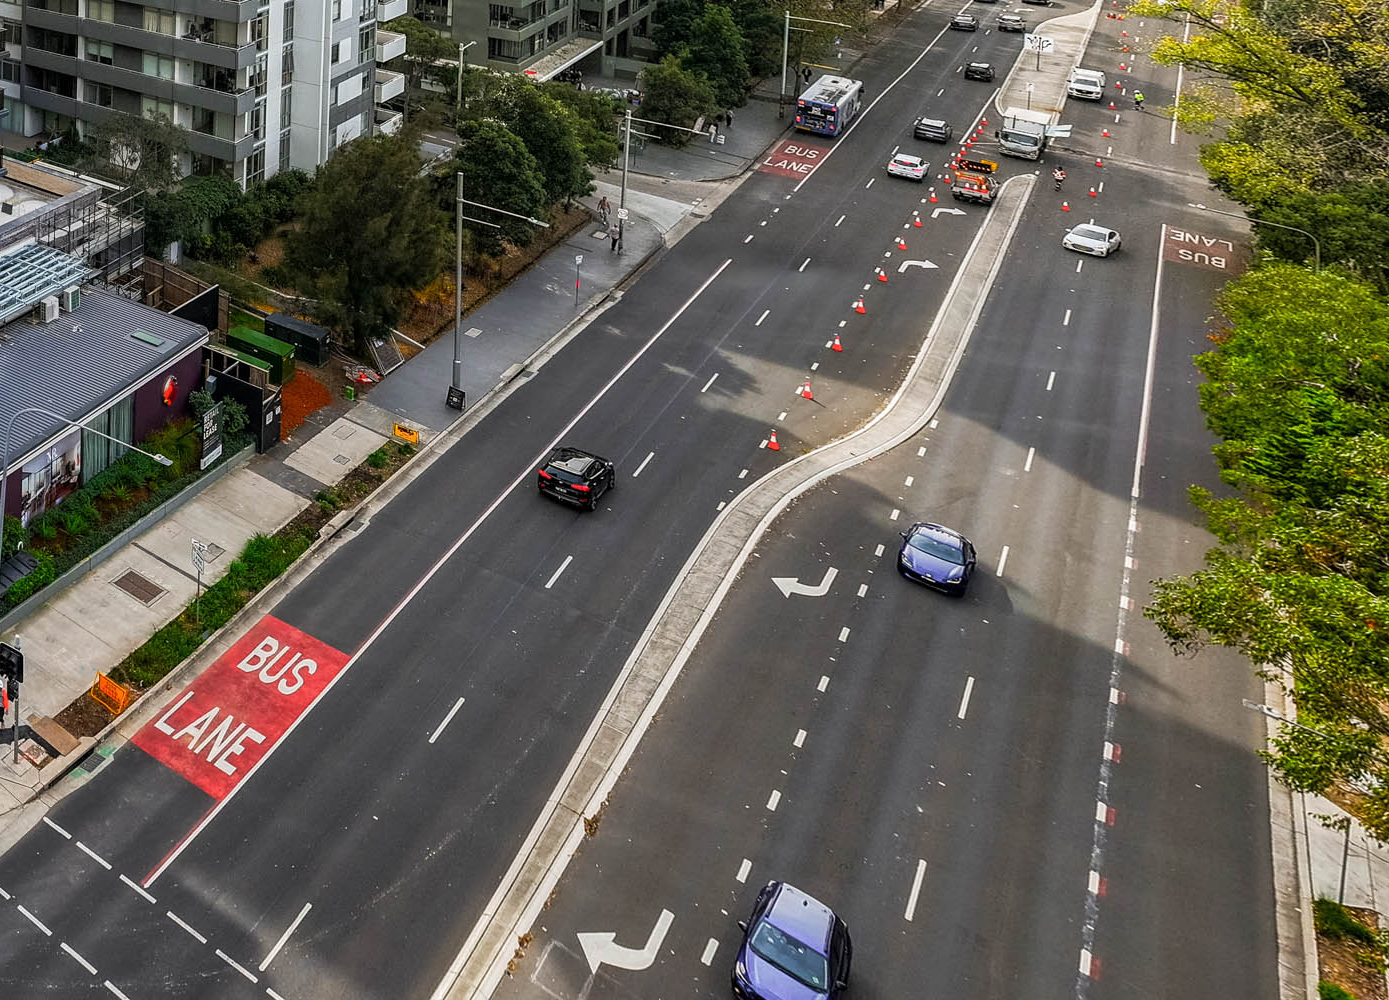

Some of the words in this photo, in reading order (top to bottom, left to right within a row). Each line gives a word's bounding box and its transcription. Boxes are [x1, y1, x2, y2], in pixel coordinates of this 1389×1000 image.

[784, 145, 820, 159] BUS
[763, 156, 815, 174] LANE
[1170, 229, 1234, 252] LANE
[1179, 249, 1226, 269] BUS
[203, 407, 220, 424] RETAIL
[203, 420, 214, 432] FOR
[203, 423, 218, 440] LEASE
[236, 635, 318, 696] BUS
[154, 690, 266, 776] LANE
